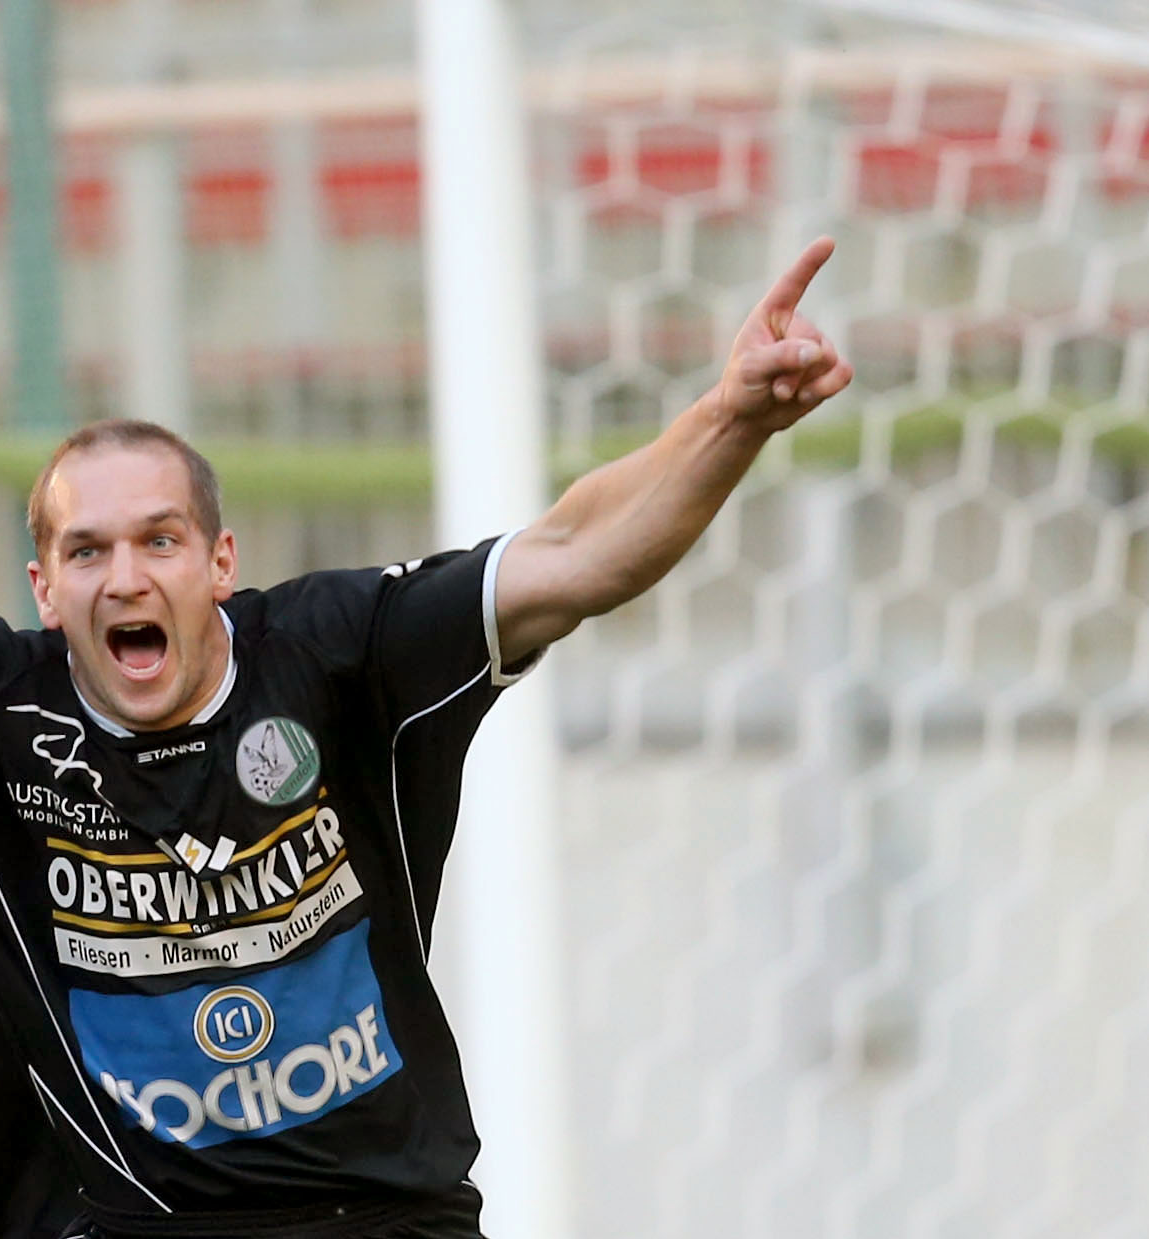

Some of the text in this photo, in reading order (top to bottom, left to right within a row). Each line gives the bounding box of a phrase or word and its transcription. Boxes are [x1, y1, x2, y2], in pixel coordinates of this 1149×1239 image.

[137, 740, 206, 763] STANNO
[85, 829, 129, 840] GMBH
[48, 807, 345, 922] OBERWINKLER
[68, 882, 346, 968] Fliesen Marmor Naturstein
[214, 1005, 255, 1044] ICI
